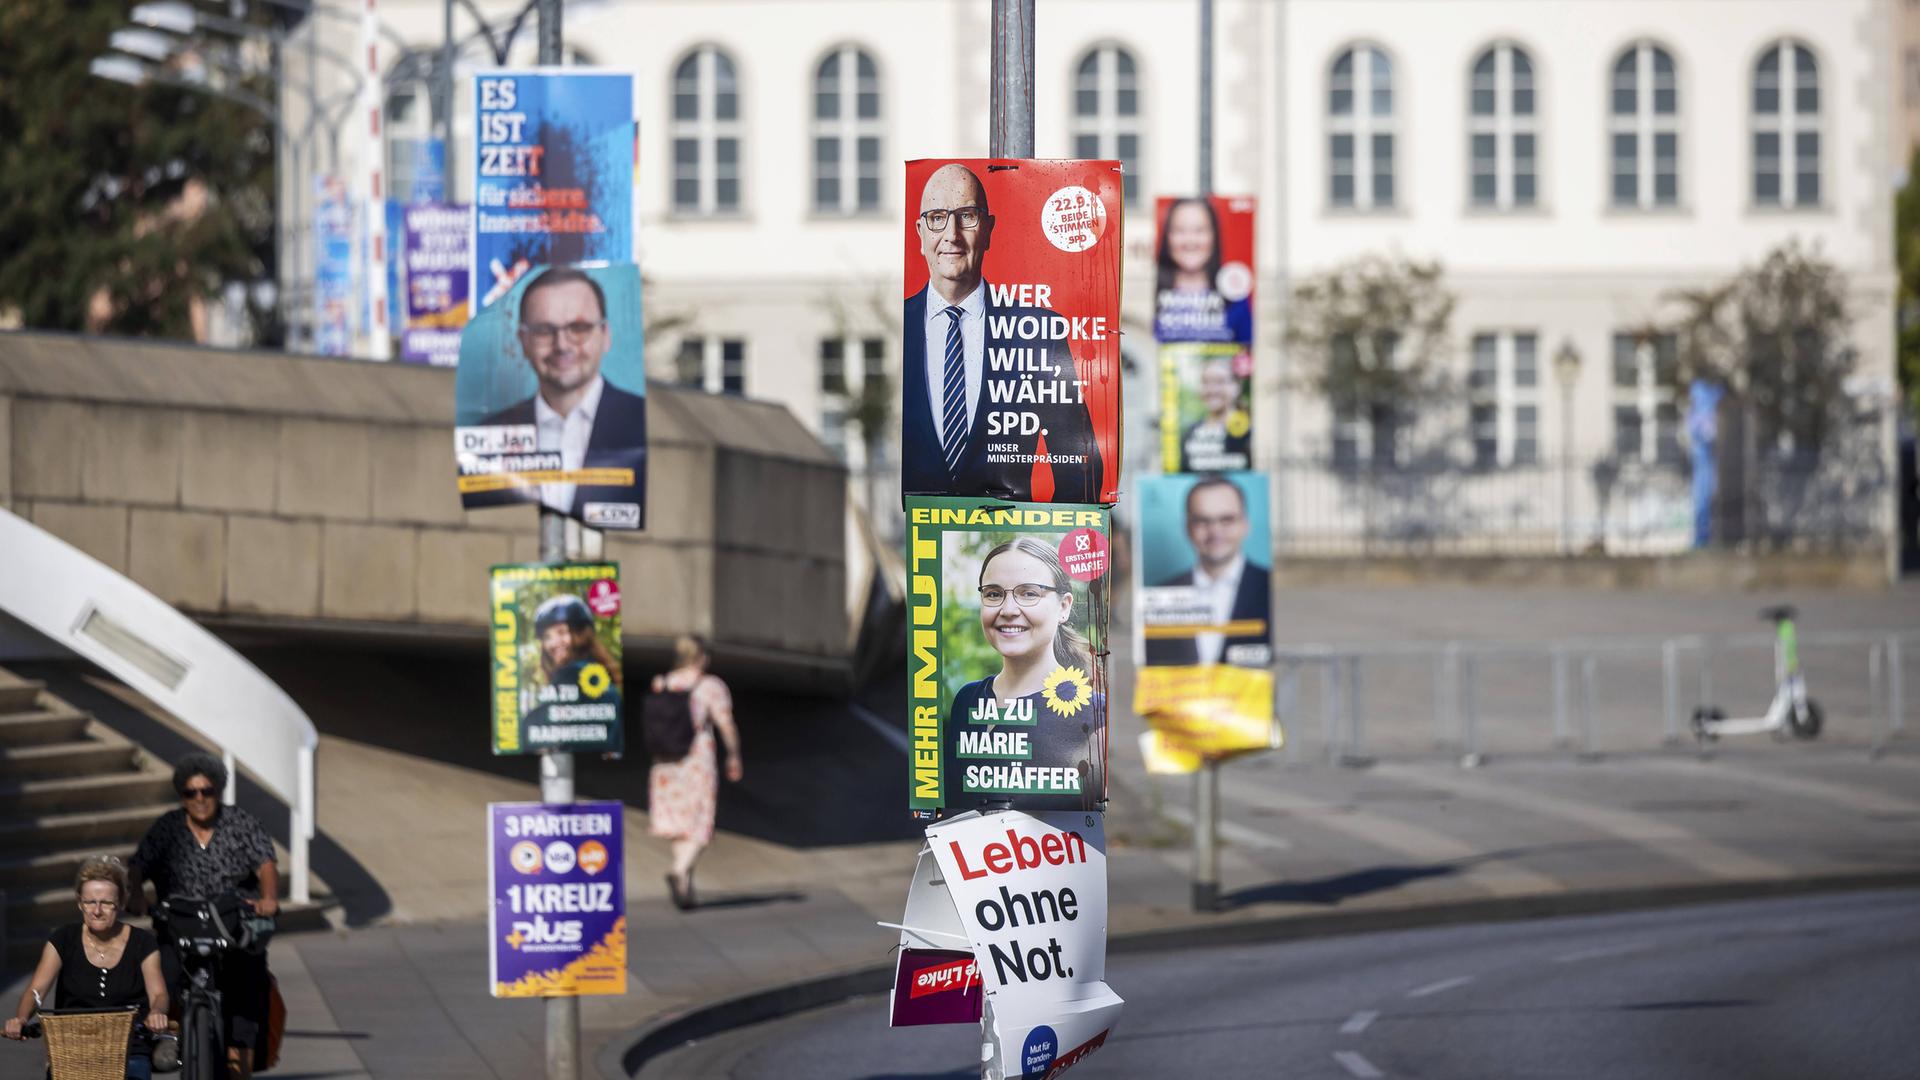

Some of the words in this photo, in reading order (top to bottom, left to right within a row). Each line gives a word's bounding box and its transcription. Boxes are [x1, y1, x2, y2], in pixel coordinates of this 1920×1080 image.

[480, 79, 516, 110] ES
[480, 112, 526, 143] IST
[480, 145, 544, 177] ZEIT
[1053, 219, 1099, 234] STIMMEN
[1061, 211, 1088, 223] BEIDE
[1068, 234, 1087, 245] SPD
[989, 284, 1052, 308] WER
[988, 316, 1106, 341] WOIDKE
[988, 347, 1061, 376] WILL,
[987, 374, 1088, 404] WÄHLT
[987, 411, 1049, 436] SPD.
[500, 431, 534, 449] Jan
[987, 443, 1019, 453] UNSER
[987, 453, 1089, 464] MINISTERPRÄSIDENT
[912, 508, 1102, 526] EINANDER
[1070, 560, 1104, 574] MARIE
[912, 526, 938, 698] MUT
[972, 698, 1000, 721] JA
[1003, 698, 1032, 721] ZU
[915, 704, 939, 798] MEHR
[959, 731, 1029, 755] MARIE
[966, 762, 1080, 790] SCHÄFFER
[505, 815, 520, 837] 3
[521, 814, 613, 837] PARTEIEN
[949, 829, 1087, 881] Leben
[506, 884, 521, 914] 1
[525, 882, 614, 914] KREUZ
[975, 885, 1078, 931] ohne
[988, 937, 1074, 986] Not.
[917, 965, 963, 988] Linke
[1029, 1043, 1041, 1054] Mut
